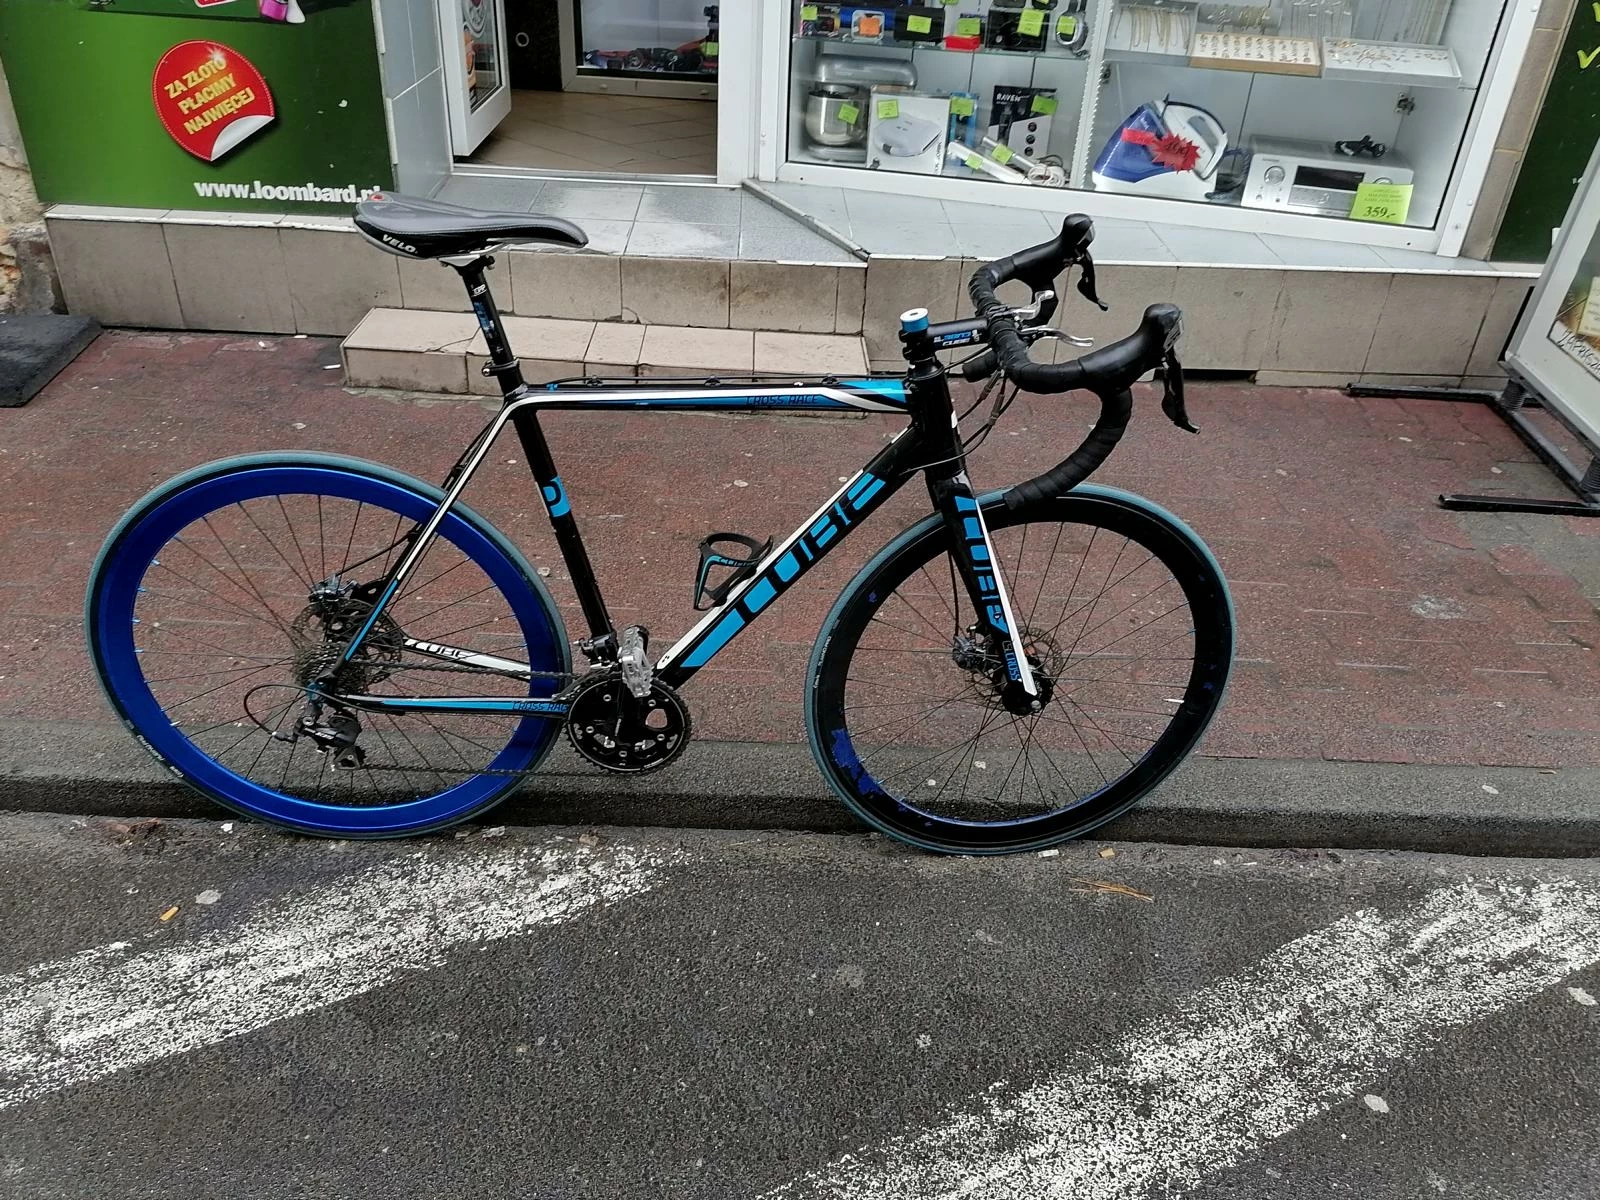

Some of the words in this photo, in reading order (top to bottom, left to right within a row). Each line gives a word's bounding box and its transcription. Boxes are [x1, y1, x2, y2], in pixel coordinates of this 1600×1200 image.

[164, 79, 188, 99] ZA
[177, 73, 237, 115] PŁACIMY
[183, 86, 256, 135] NAJWIĘCEJ
[382, 233, 416, 253] VELO
[746, 394, 785, 406] CROSS
[788, 394, 819, 405] RACE
[513, 701, 545, 711] CROSS
